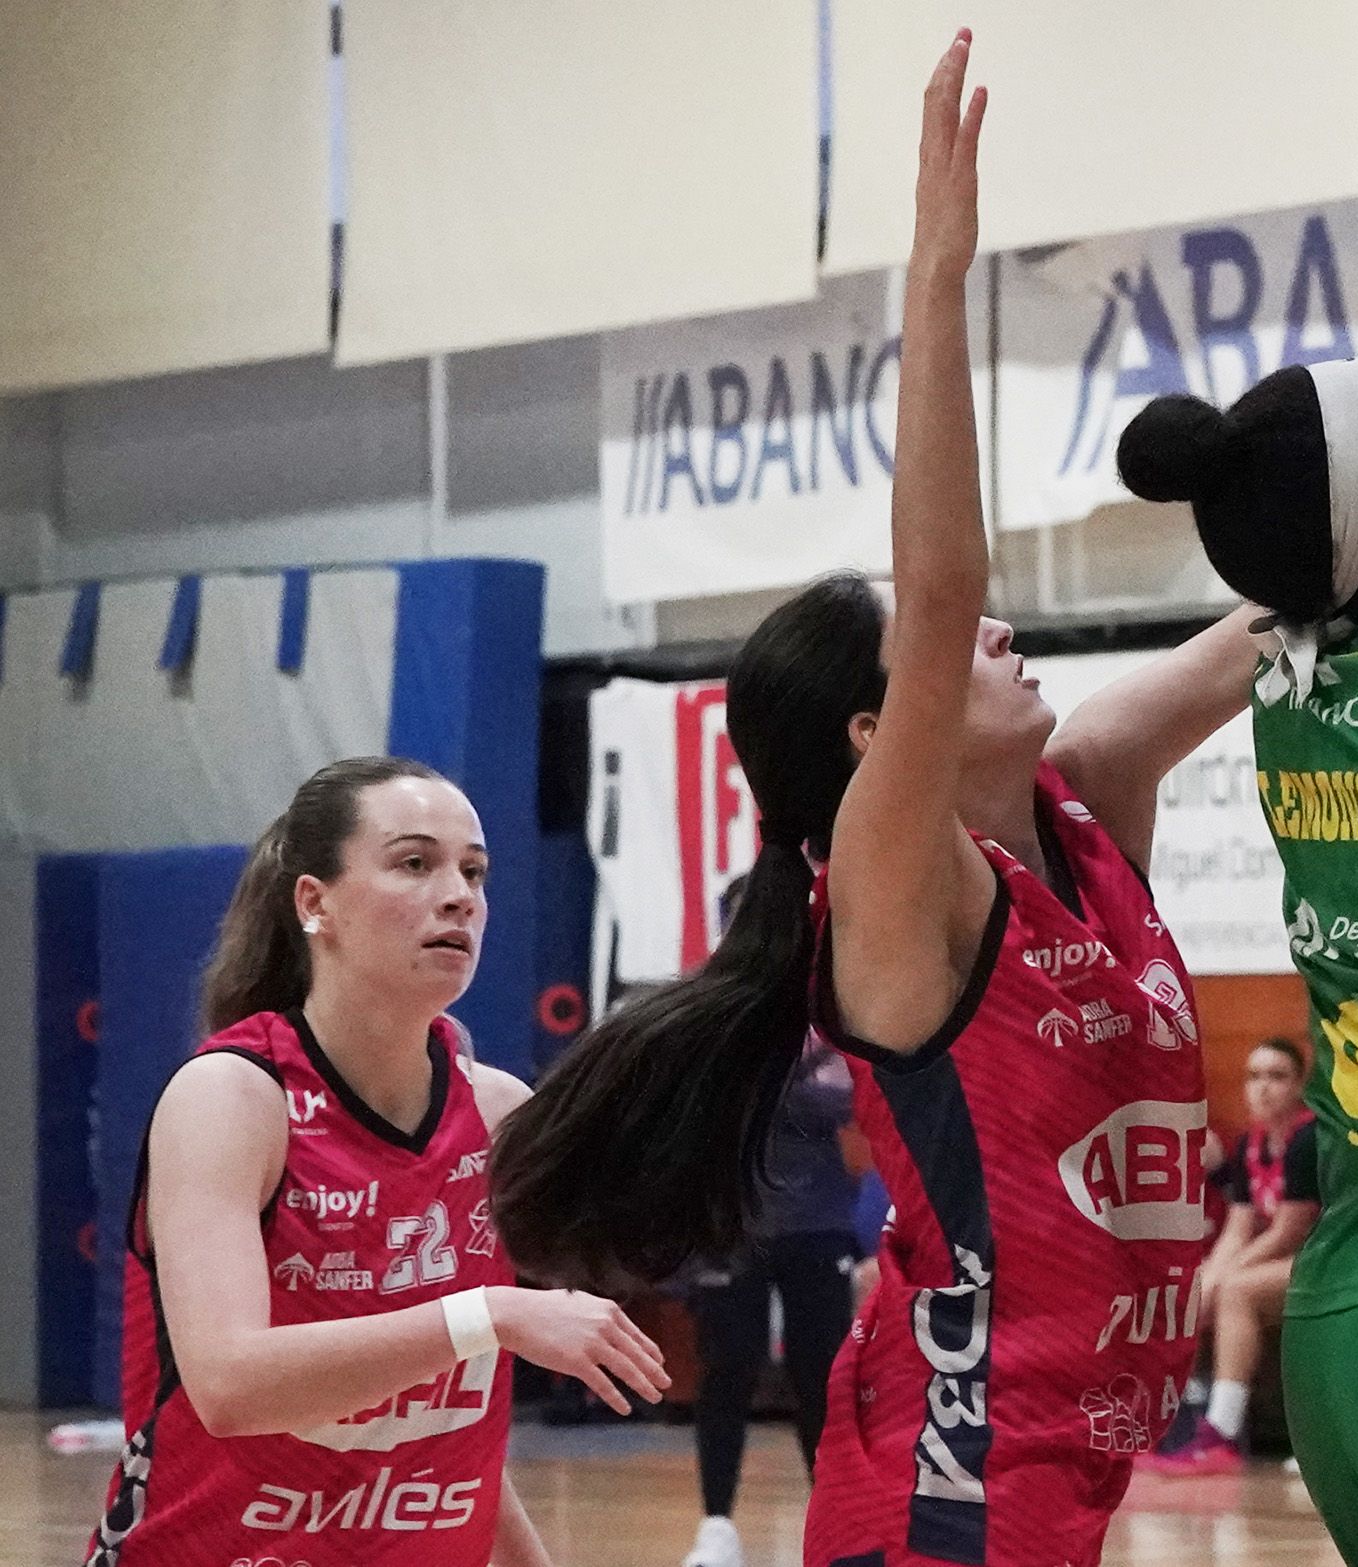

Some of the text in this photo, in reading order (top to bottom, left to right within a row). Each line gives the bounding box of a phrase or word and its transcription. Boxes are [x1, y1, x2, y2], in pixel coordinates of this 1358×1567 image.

[624, 334, 902, 515] ABANC
[1022, 937, 1116, 978] enjoy!
[1084, 1014, 1133, 1045] SANFER
[286, 1180, 379, 1219] enjoy!
[378, 1199, 458, 1295] 22
[240, 1466, 483, 1533] avilés
